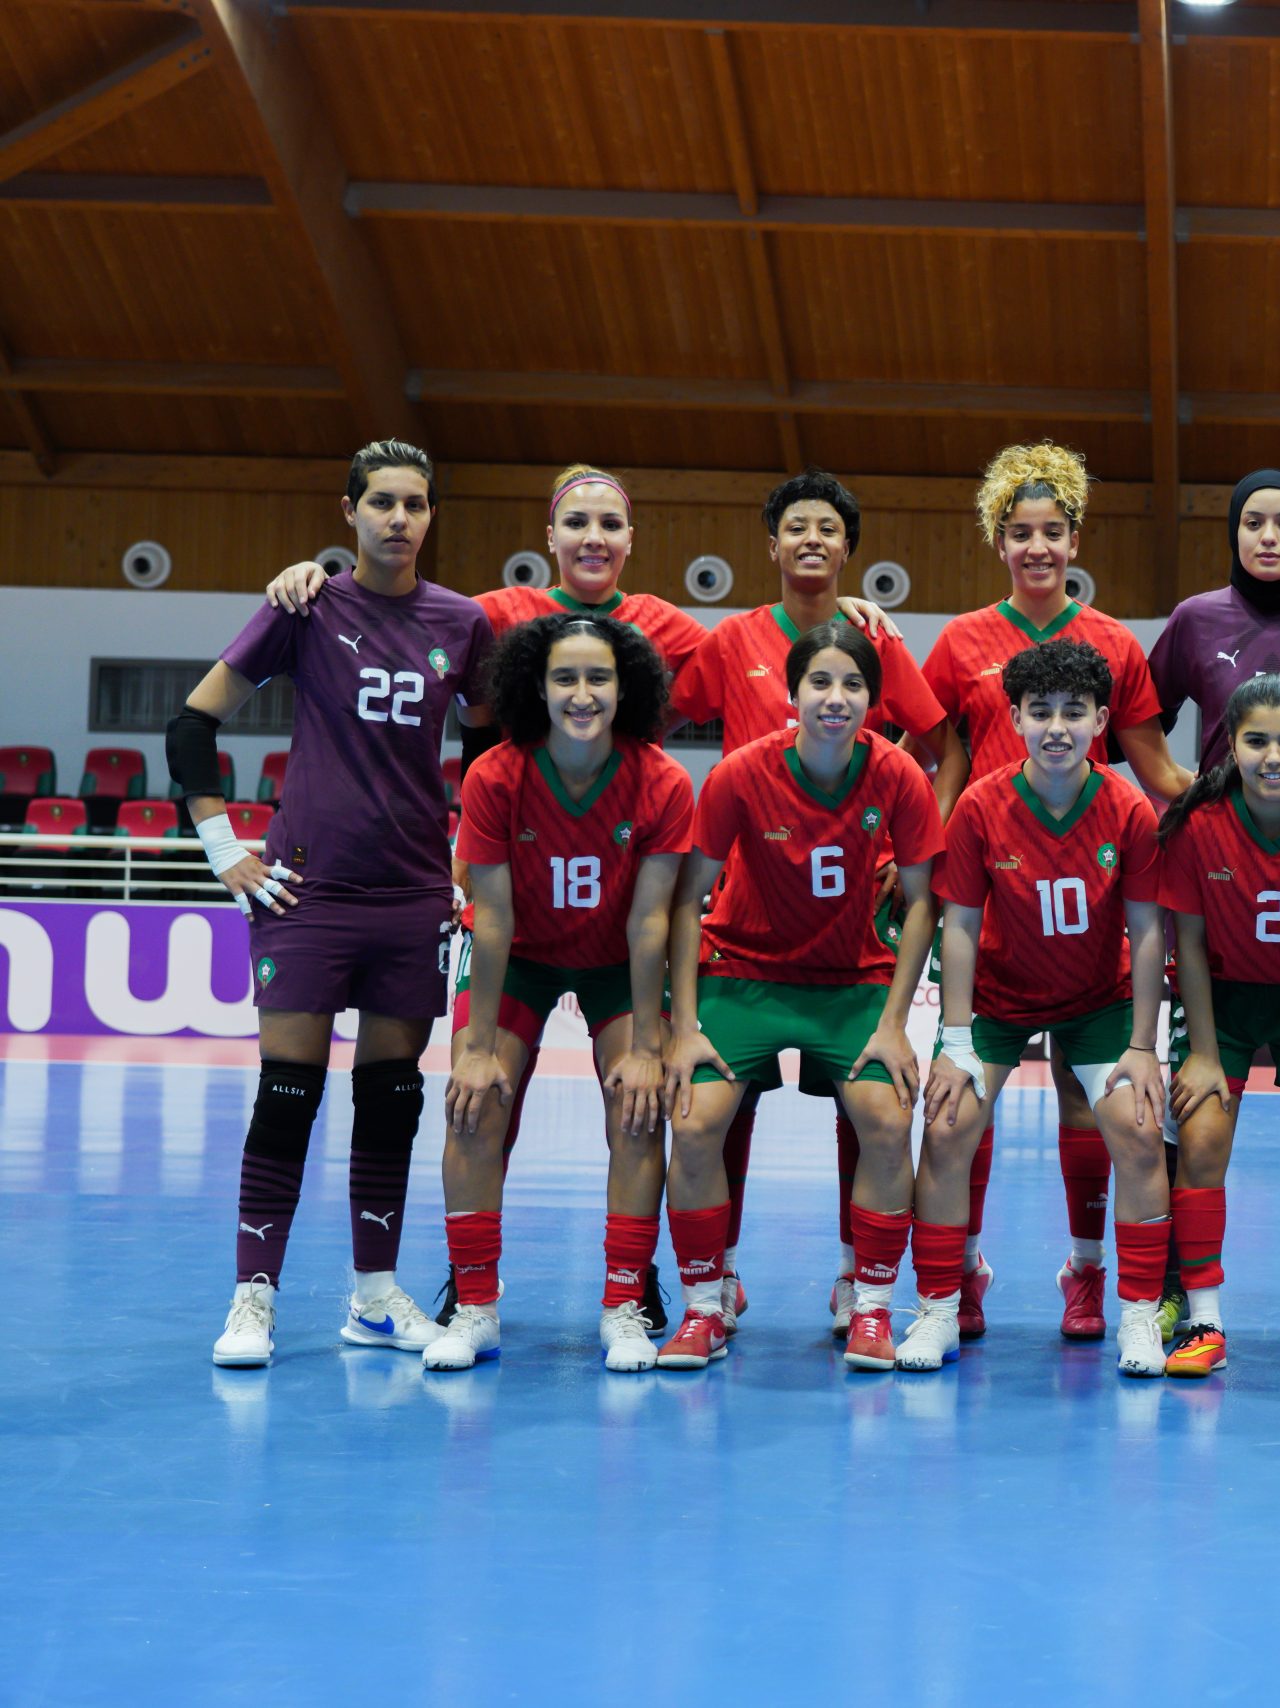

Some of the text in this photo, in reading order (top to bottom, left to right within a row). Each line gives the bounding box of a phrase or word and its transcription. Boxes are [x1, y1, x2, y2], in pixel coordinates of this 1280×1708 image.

[358, 667, 425, 727] 22
[810, 845, 846, 898] 6
[995, 861, 1018, 870] PUMA
[550, 855, 601, 909] 18
[1207, 871, 1231, 881] PUMA
[1036, 877, 1090, 937] 10
[272, 1084, 306, 1097] ALLSIX
[607, 1272, 635, 1285] PUMA
[860, 1266, 893, 1279] PUMA
